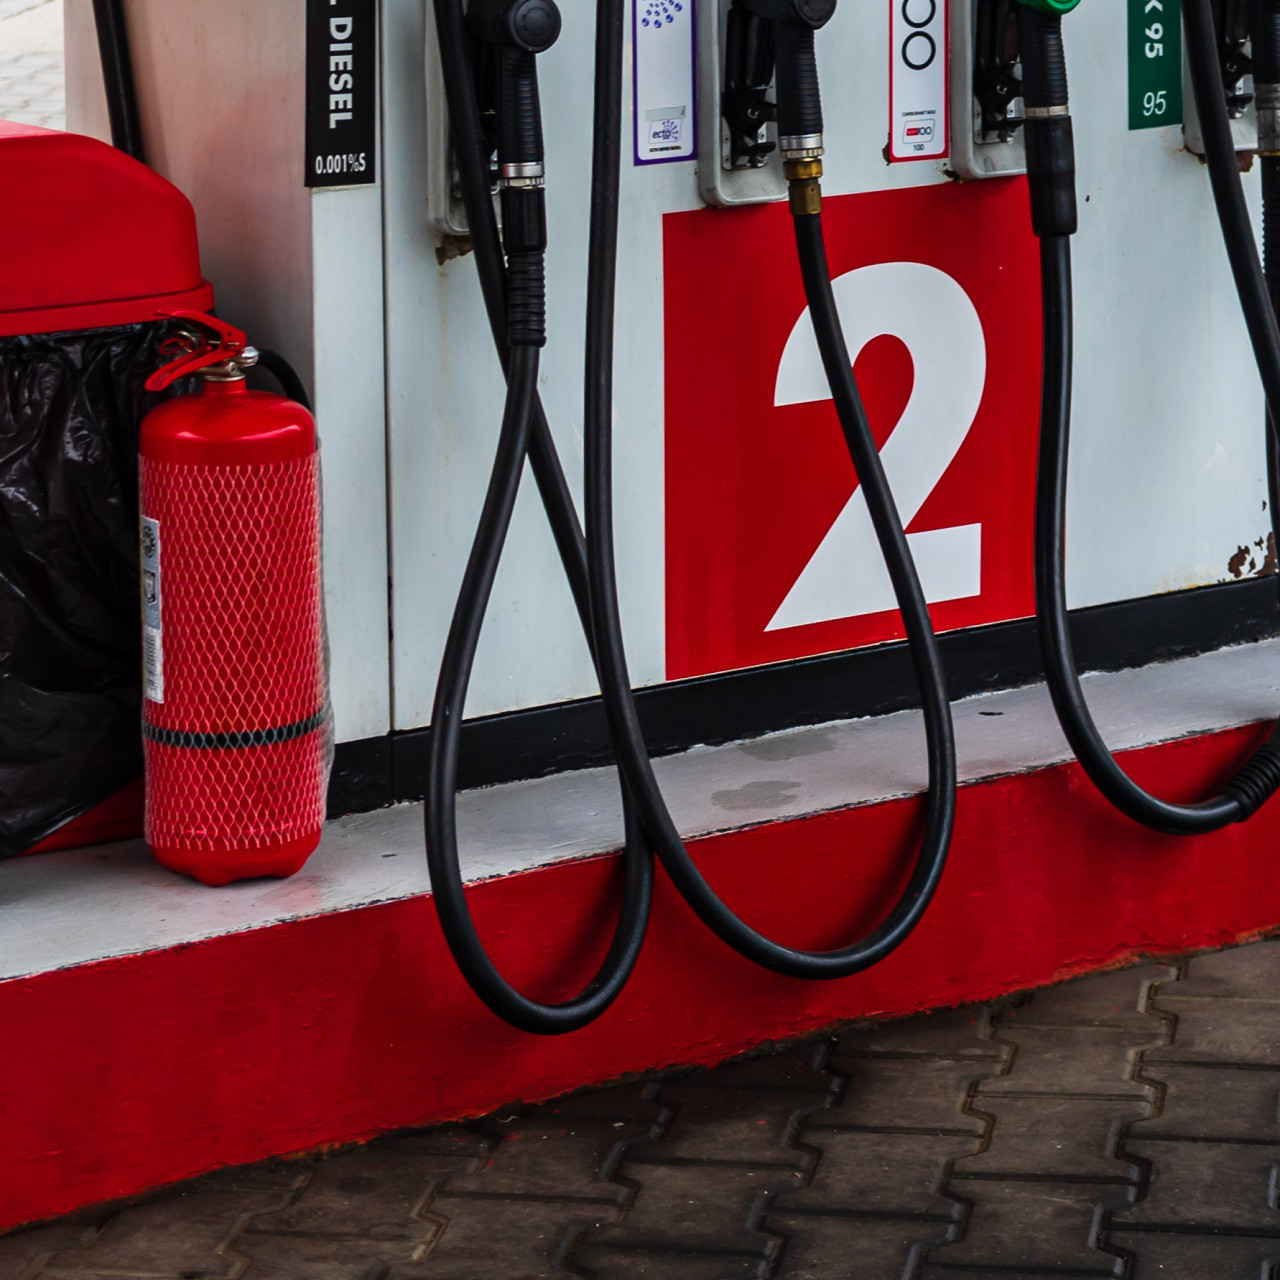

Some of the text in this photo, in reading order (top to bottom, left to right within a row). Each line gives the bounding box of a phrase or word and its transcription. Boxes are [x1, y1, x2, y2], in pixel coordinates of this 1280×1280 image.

[1144, 22, 1164, 59] 95
[329, 16, 354, 129] DIESEL
[1142, 90, 1167, 117] 95
[315, 152, 366, 175] 0.001%S
[763, 261, 987, 633] 2
